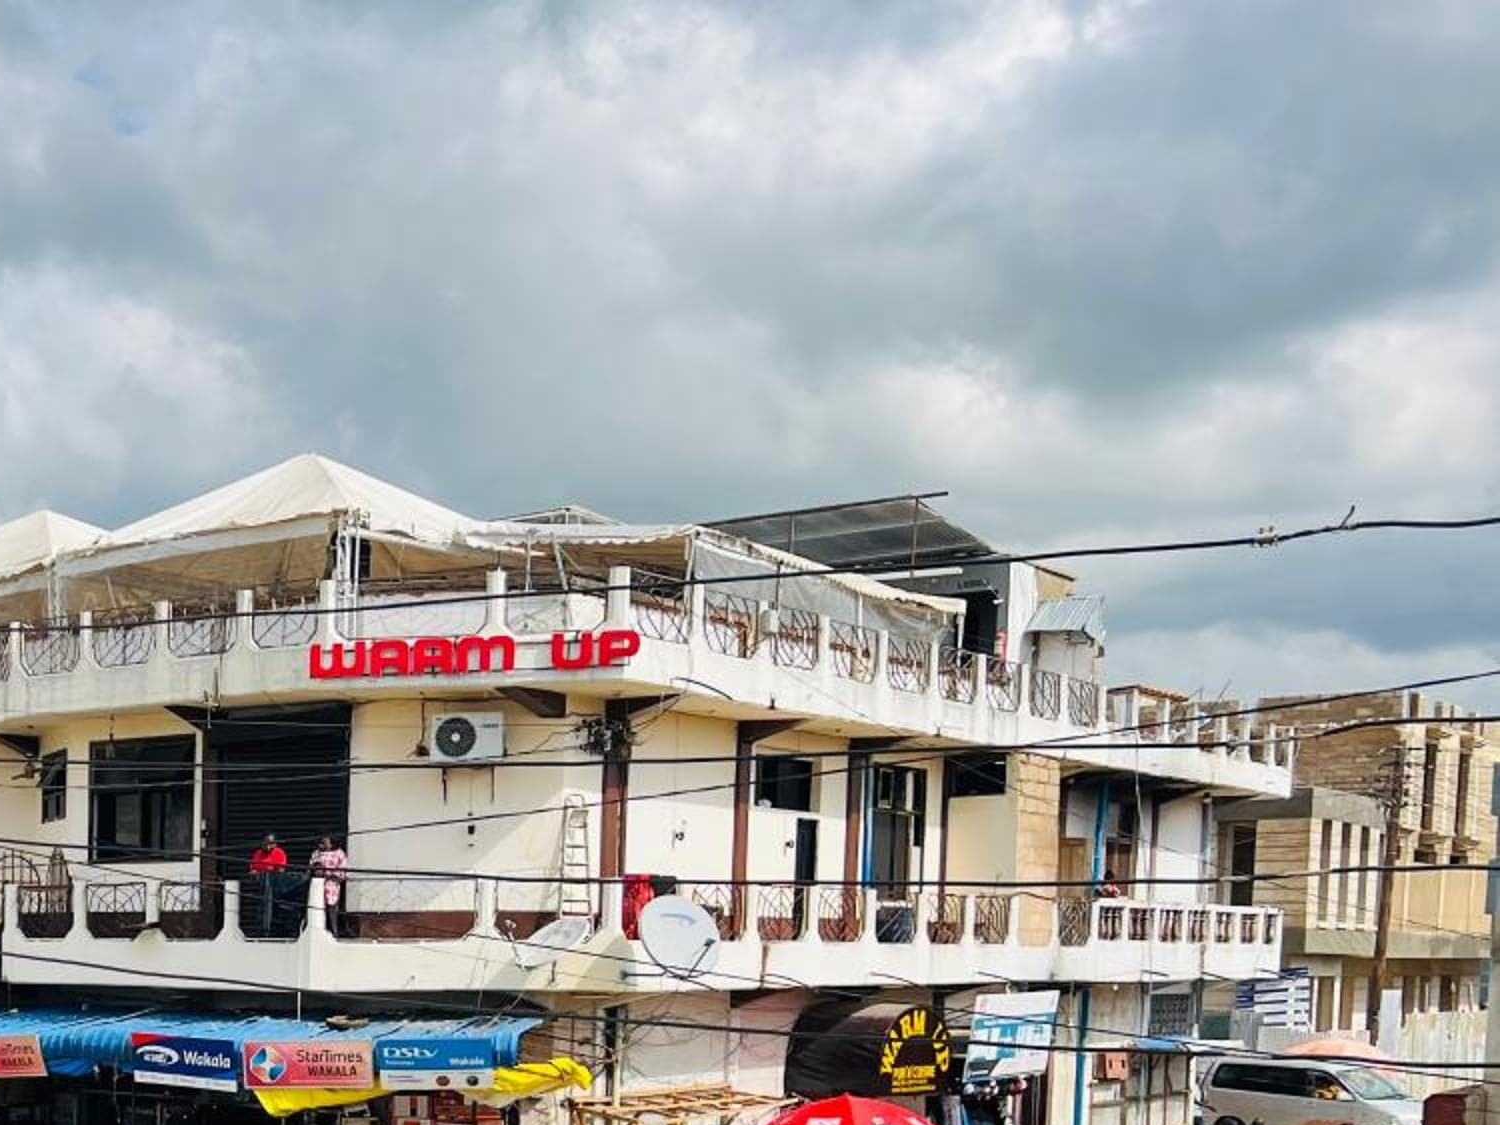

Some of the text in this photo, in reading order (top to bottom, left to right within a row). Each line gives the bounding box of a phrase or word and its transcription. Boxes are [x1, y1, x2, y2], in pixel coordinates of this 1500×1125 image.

[551, 630, 641, 671] UP
[183, 1050, 232, 1069] Wakala
[297, 1049, 363, 1063] StarTimes
[383, 1047, 439, 1058] DStv
[308, 1065, 357, 1077] WAKALA
